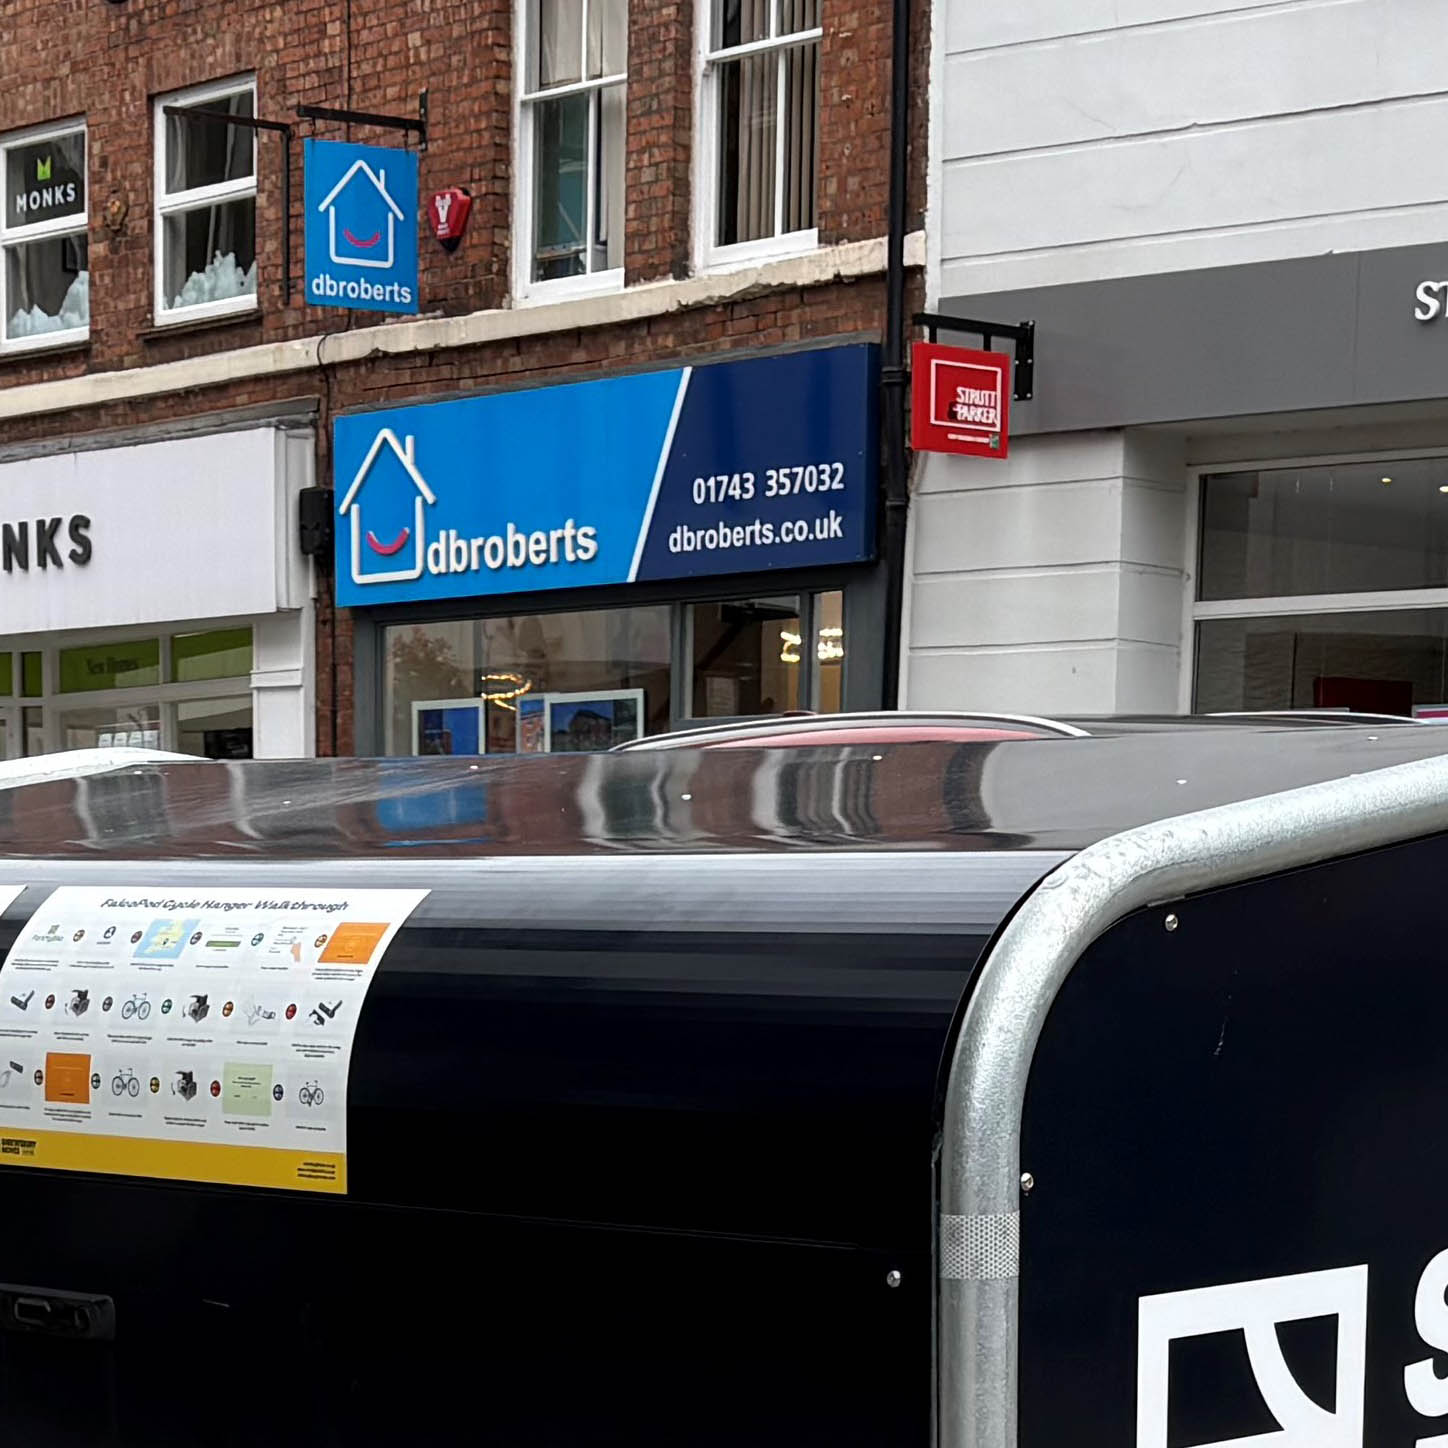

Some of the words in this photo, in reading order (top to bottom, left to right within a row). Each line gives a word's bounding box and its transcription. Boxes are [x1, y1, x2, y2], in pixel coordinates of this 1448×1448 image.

[312, 273, 412, 304] dbroberts
[956, 386, 998, 407] STRUTT
[692, 473, 755, 505] 01743
[764, 462, 844, 498] 357032
[427, 518, 598, 575] dbroberts
[668, 510, 844, 554] dbroberts.co.uk
[202, 900, 252, 911] Hanger
[16, 1183, 75, 1213] MONKS
